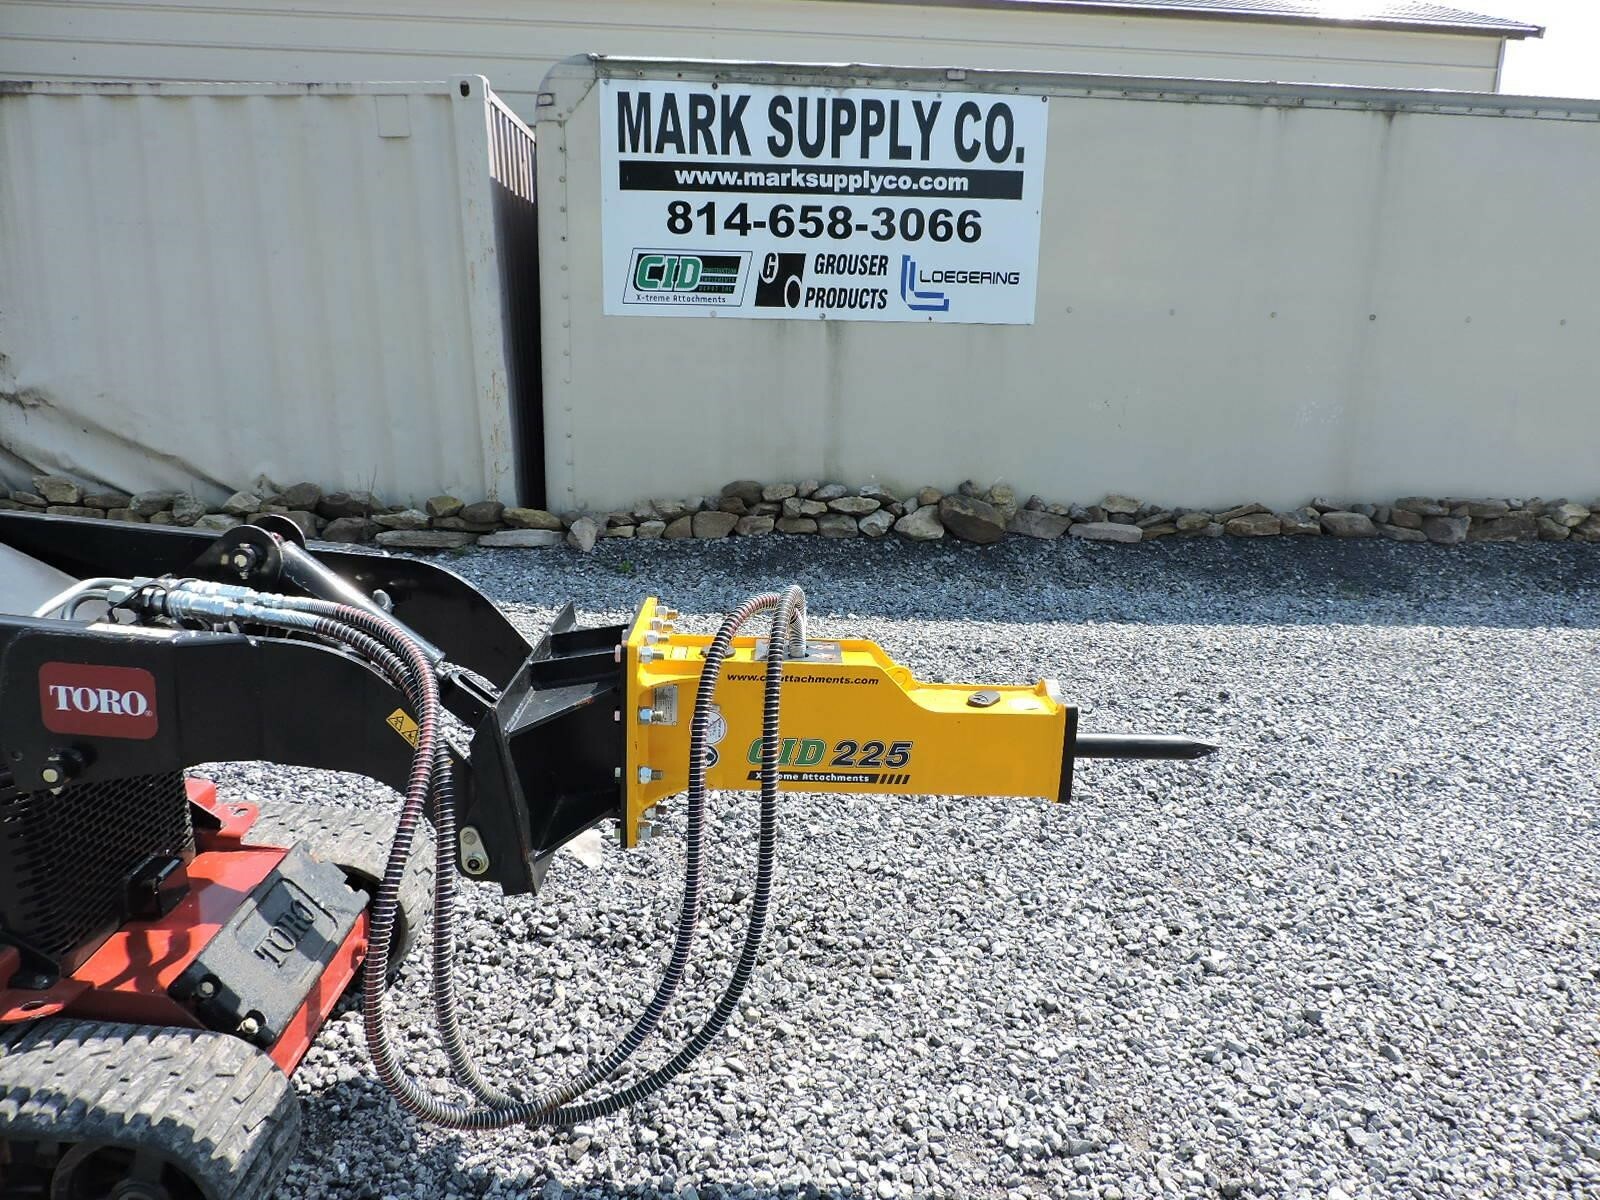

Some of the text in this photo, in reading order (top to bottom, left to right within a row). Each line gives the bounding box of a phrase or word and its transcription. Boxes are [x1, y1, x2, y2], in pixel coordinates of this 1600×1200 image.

[617, 91, 1025, 164] MARK SUPPLY CO.
[675, 168, 969, 195] www.marksupplyco.com
[667, 200, 982, 243] 814-658-3066
[636, 254, 703, 291] CID
[814, 253, 889, 276] GROUSER
[920, 269, 1020, 285] LOEGERING
[636, 294, 726, 303] X-treme Attachments
[804, 286, 888, 309] PRODUCTS
[727, 673, 879, 685] www.cttachments.com
[49, 685, 148, 716] TORO
[829, 739, 913, 769] 225
[802, 773, 870, 783] Attachments
[254, 900, 316, 968] TORO
